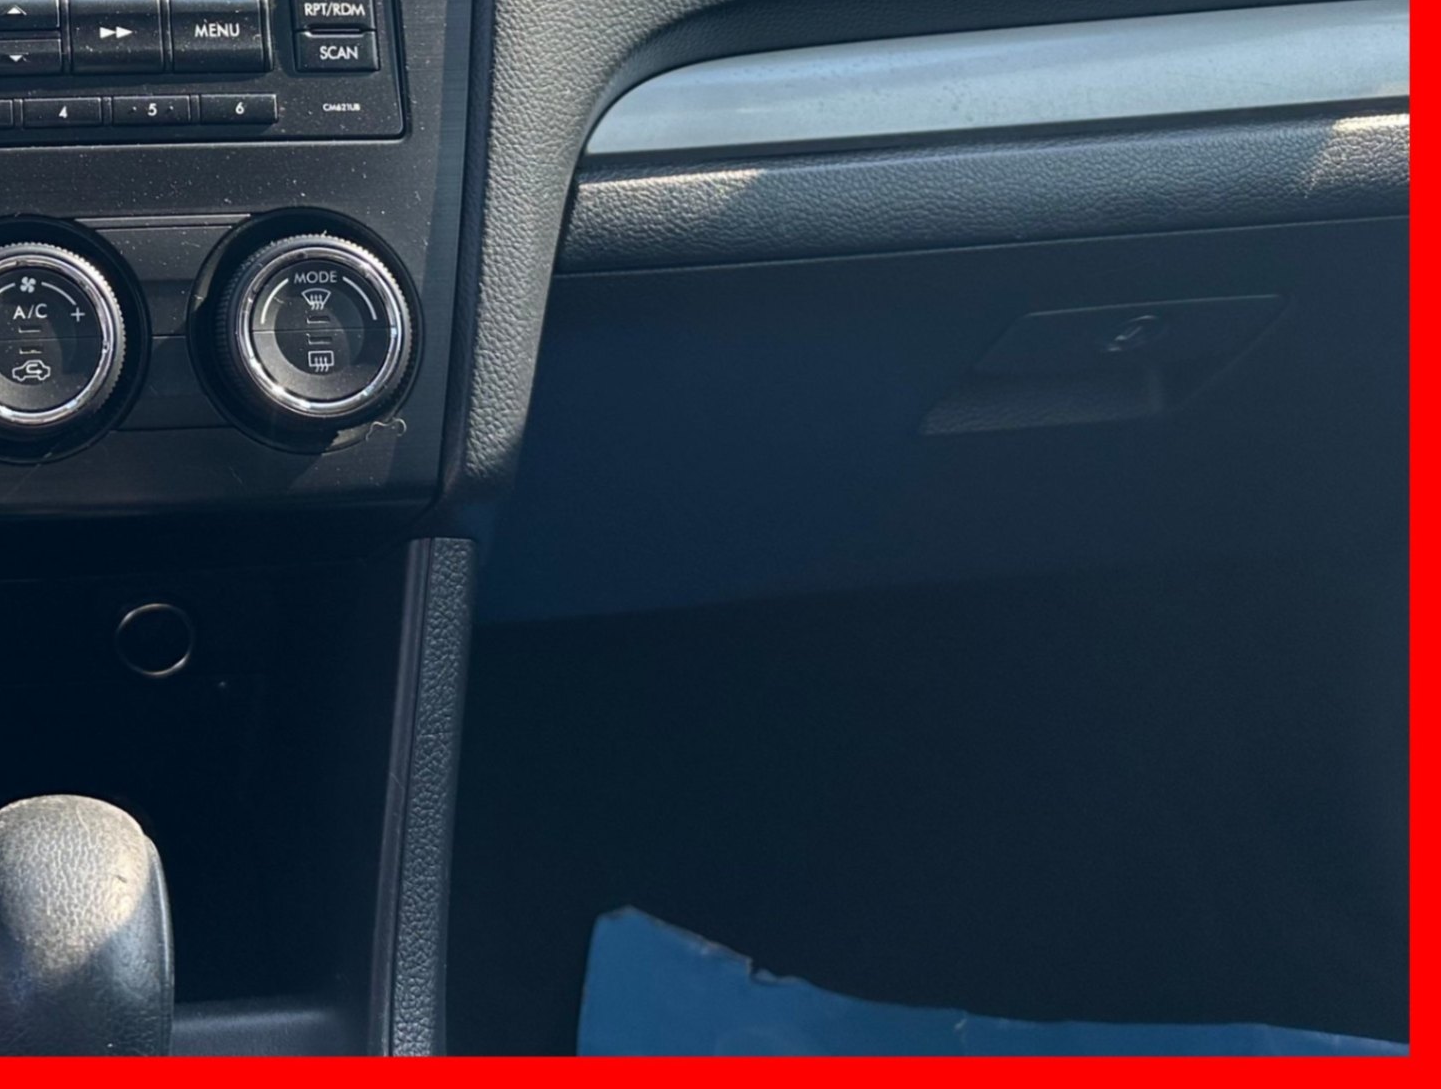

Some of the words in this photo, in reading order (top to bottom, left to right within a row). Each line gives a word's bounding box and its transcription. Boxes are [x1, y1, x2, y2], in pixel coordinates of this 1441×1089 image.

[304, 2, 365, 16] RPT/RDM
[195, 22, 240, 38] MENU
[320, 46, 358, 60] SCAN
[59, 106, 67, 118] 4
[148, 103, 157, 116] 5
[235, 102, 246, 114] 6
[294, 270, 337, 284] MODE
[12, 303, 47, 320] A/C
